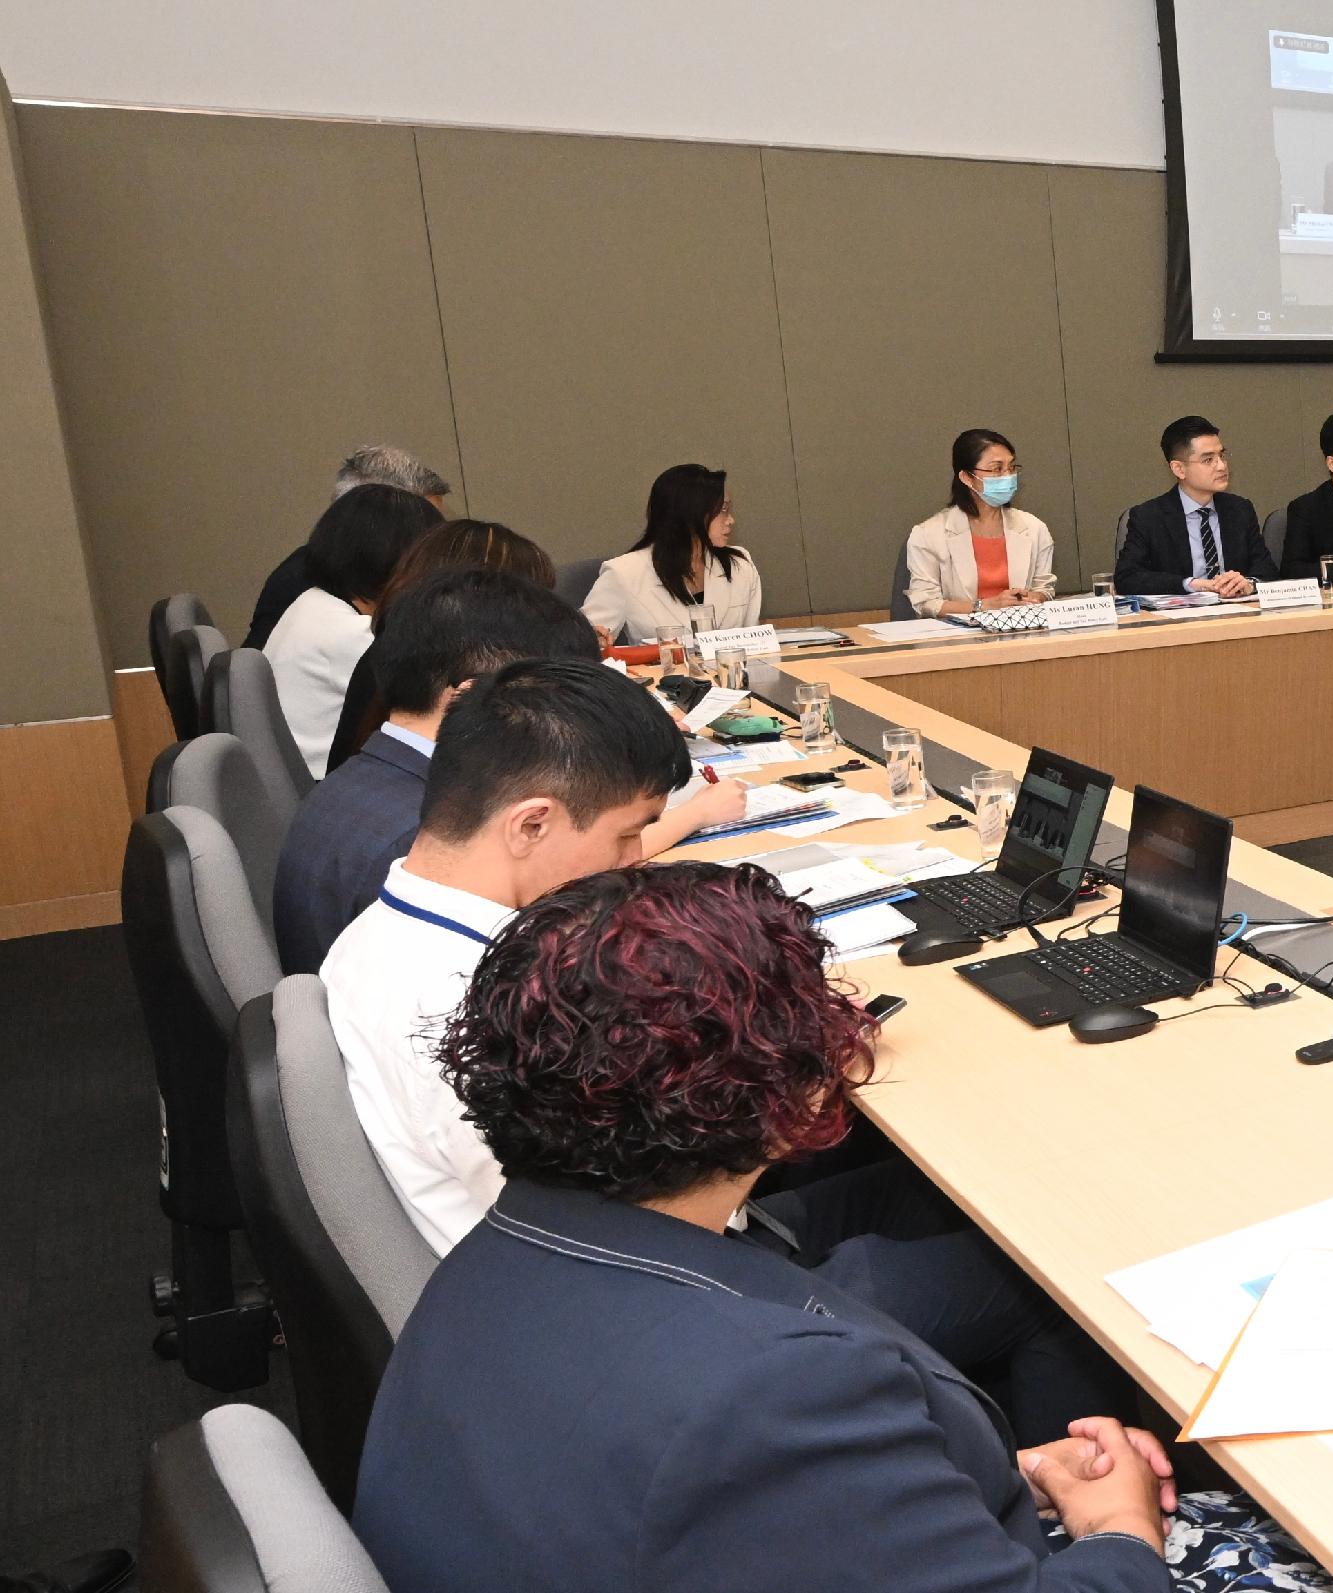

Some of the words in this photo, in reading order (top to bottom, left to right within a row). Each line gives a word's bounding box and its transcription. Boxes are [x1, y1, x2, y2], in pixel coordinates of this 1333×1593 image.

[1298, 583, 1317, 592] CHAN
[1085, 601, 1111, 611] HUNG
[715, 633, 741, 643] Karen
[743, 629, 773, 640] CHOW
